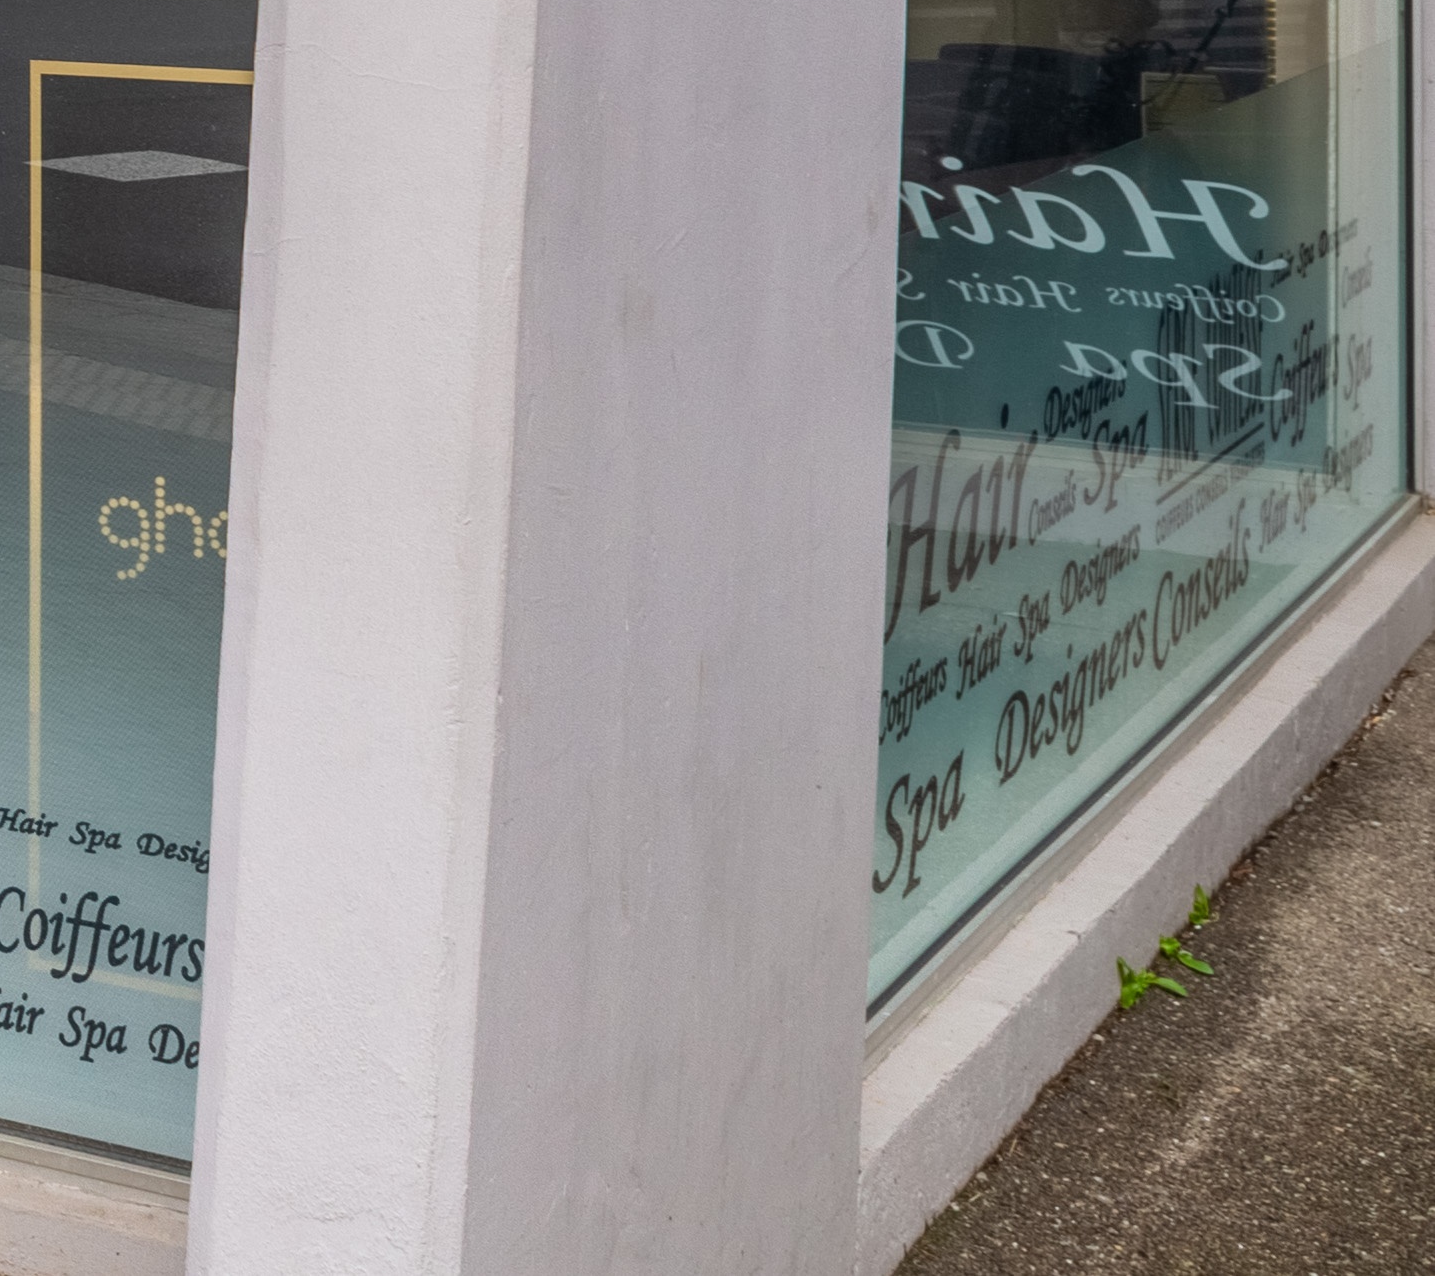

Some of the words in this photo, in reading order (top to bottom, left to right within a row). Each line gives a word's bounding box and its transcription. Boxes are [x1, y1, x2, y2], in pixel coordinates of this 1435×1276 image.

[1044, 358, 1127, 442] Designers
[884, 403, 1039, 643] Hair
[1028, 468, 1077, 546] Conseils
[1083, 411, 1149, 514] Spa
[872, 748, 966, 899] Spa
[996, 607, 1148, 786] Designers
[1152, 496, 1251, 672] Conseils
[878, 657, 948, 743] Coiffeurs
[956, 613, 1007, 700] Hair
[1013, 589, 1051, 664] Spa
[1060, 523, 1141, 616] Designers
[69, 821, 123, 854] Spa
[58, 1005, 128, 1063] Spa
